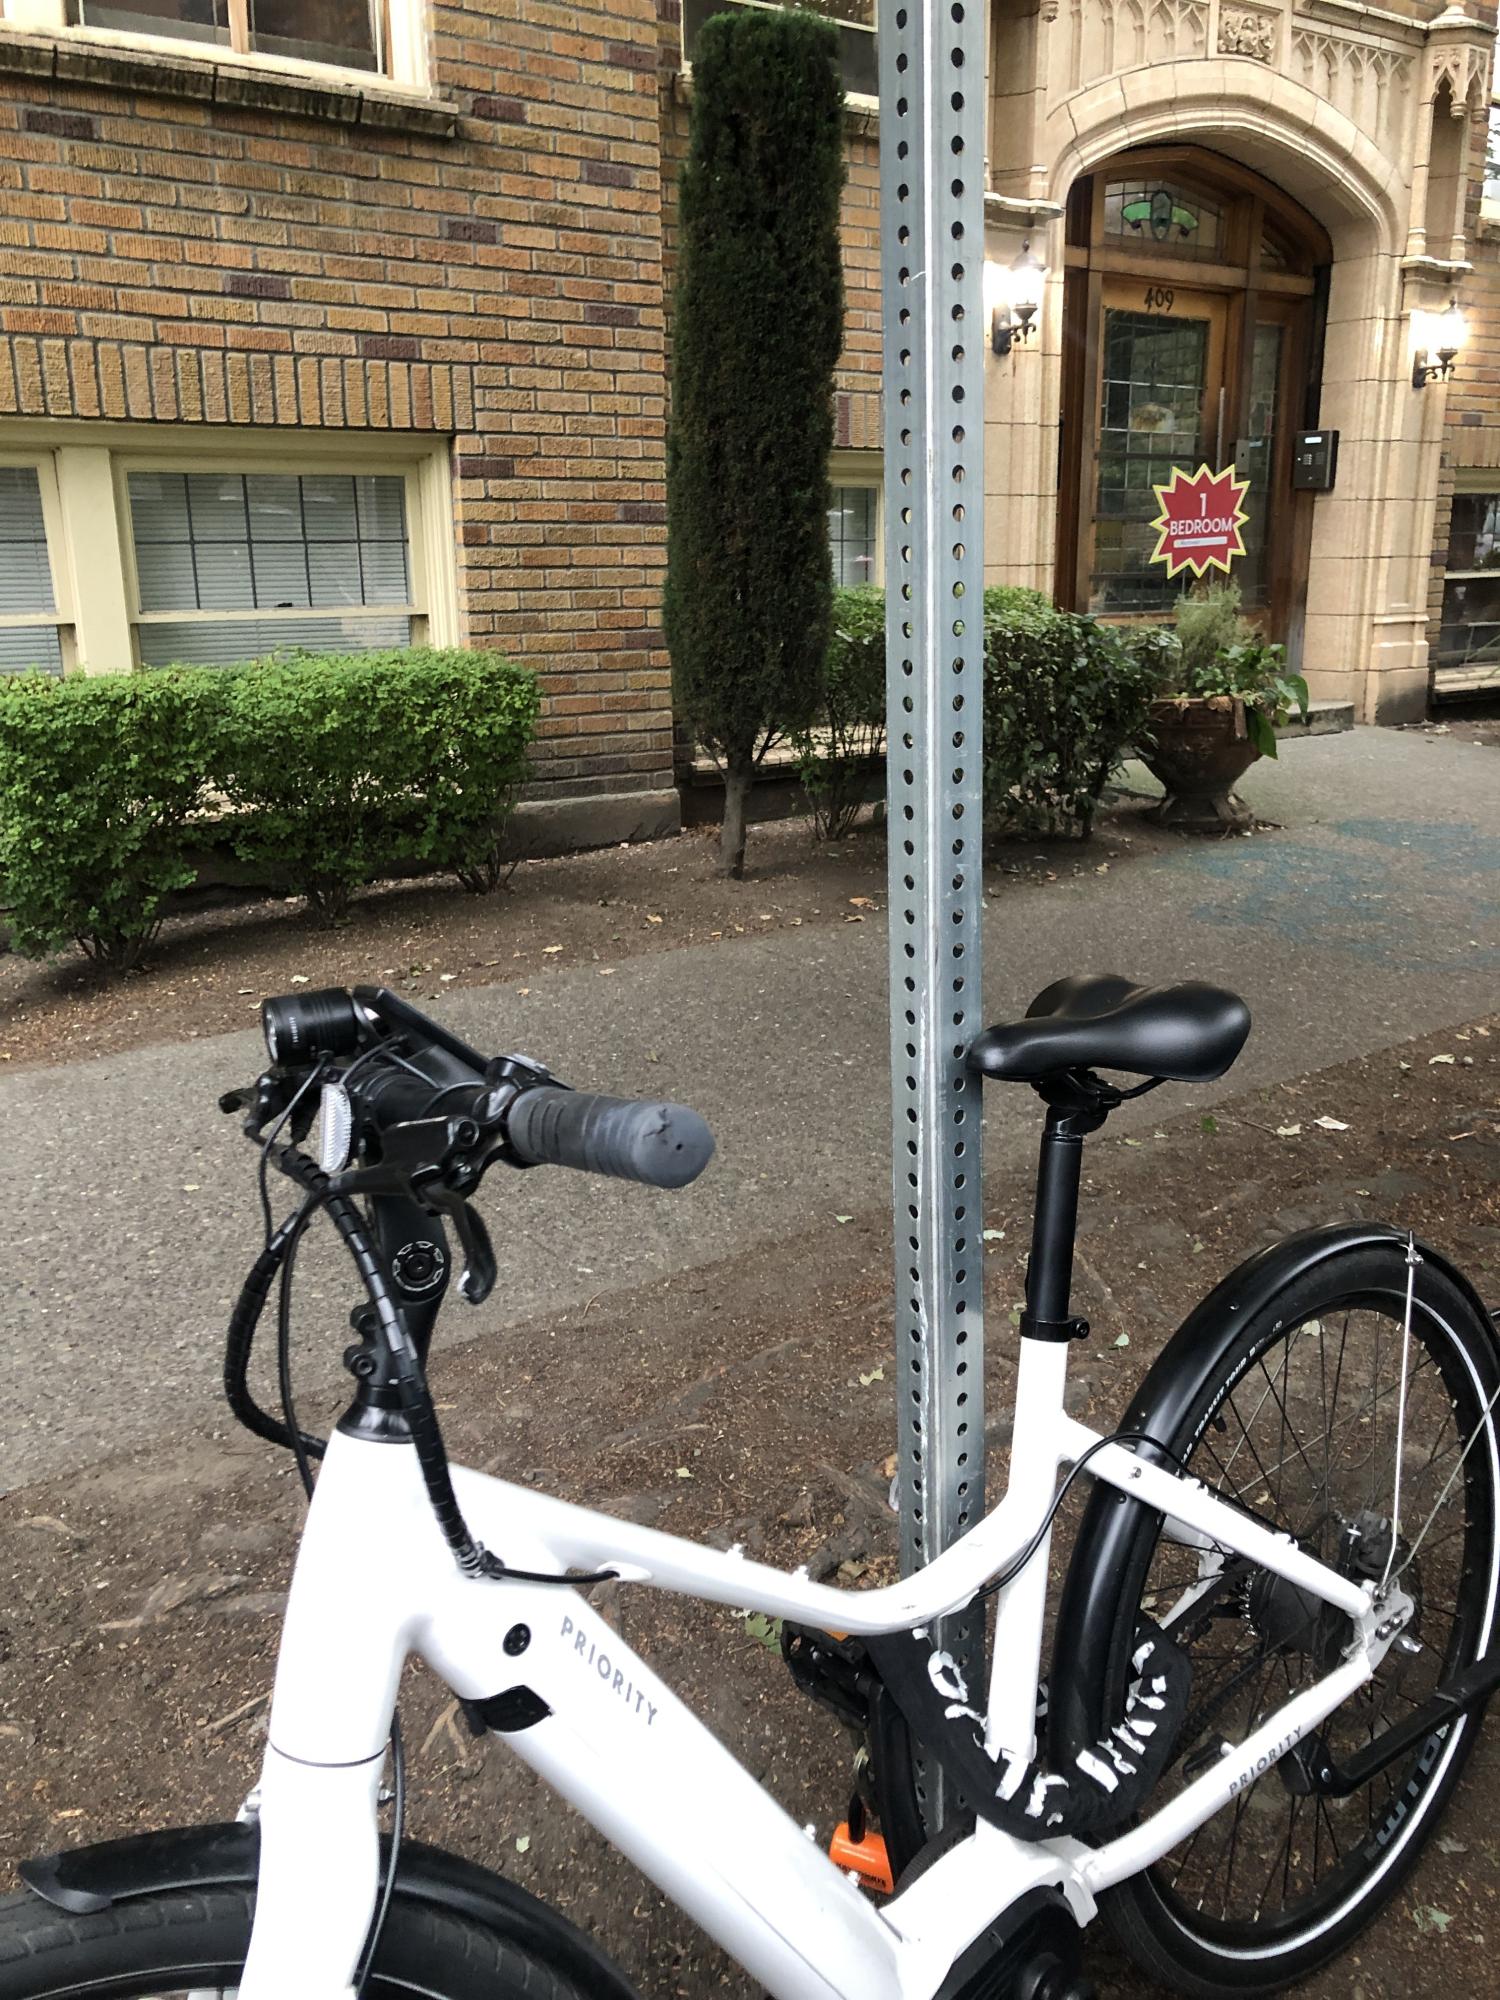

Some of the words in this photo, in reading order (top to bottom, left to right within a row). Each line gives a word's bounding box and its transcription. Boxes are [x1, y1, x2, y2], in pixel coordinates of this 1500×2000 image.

[1144, 287, 1174, 312] 409
[1199, 492, 1207, 517] 1
[1169, 516, 1233, 536] BEDROOM
[561, 1615, 658, 1726] PRIORITY
[1229, 1725, 1302, 1796] PRIORITY
